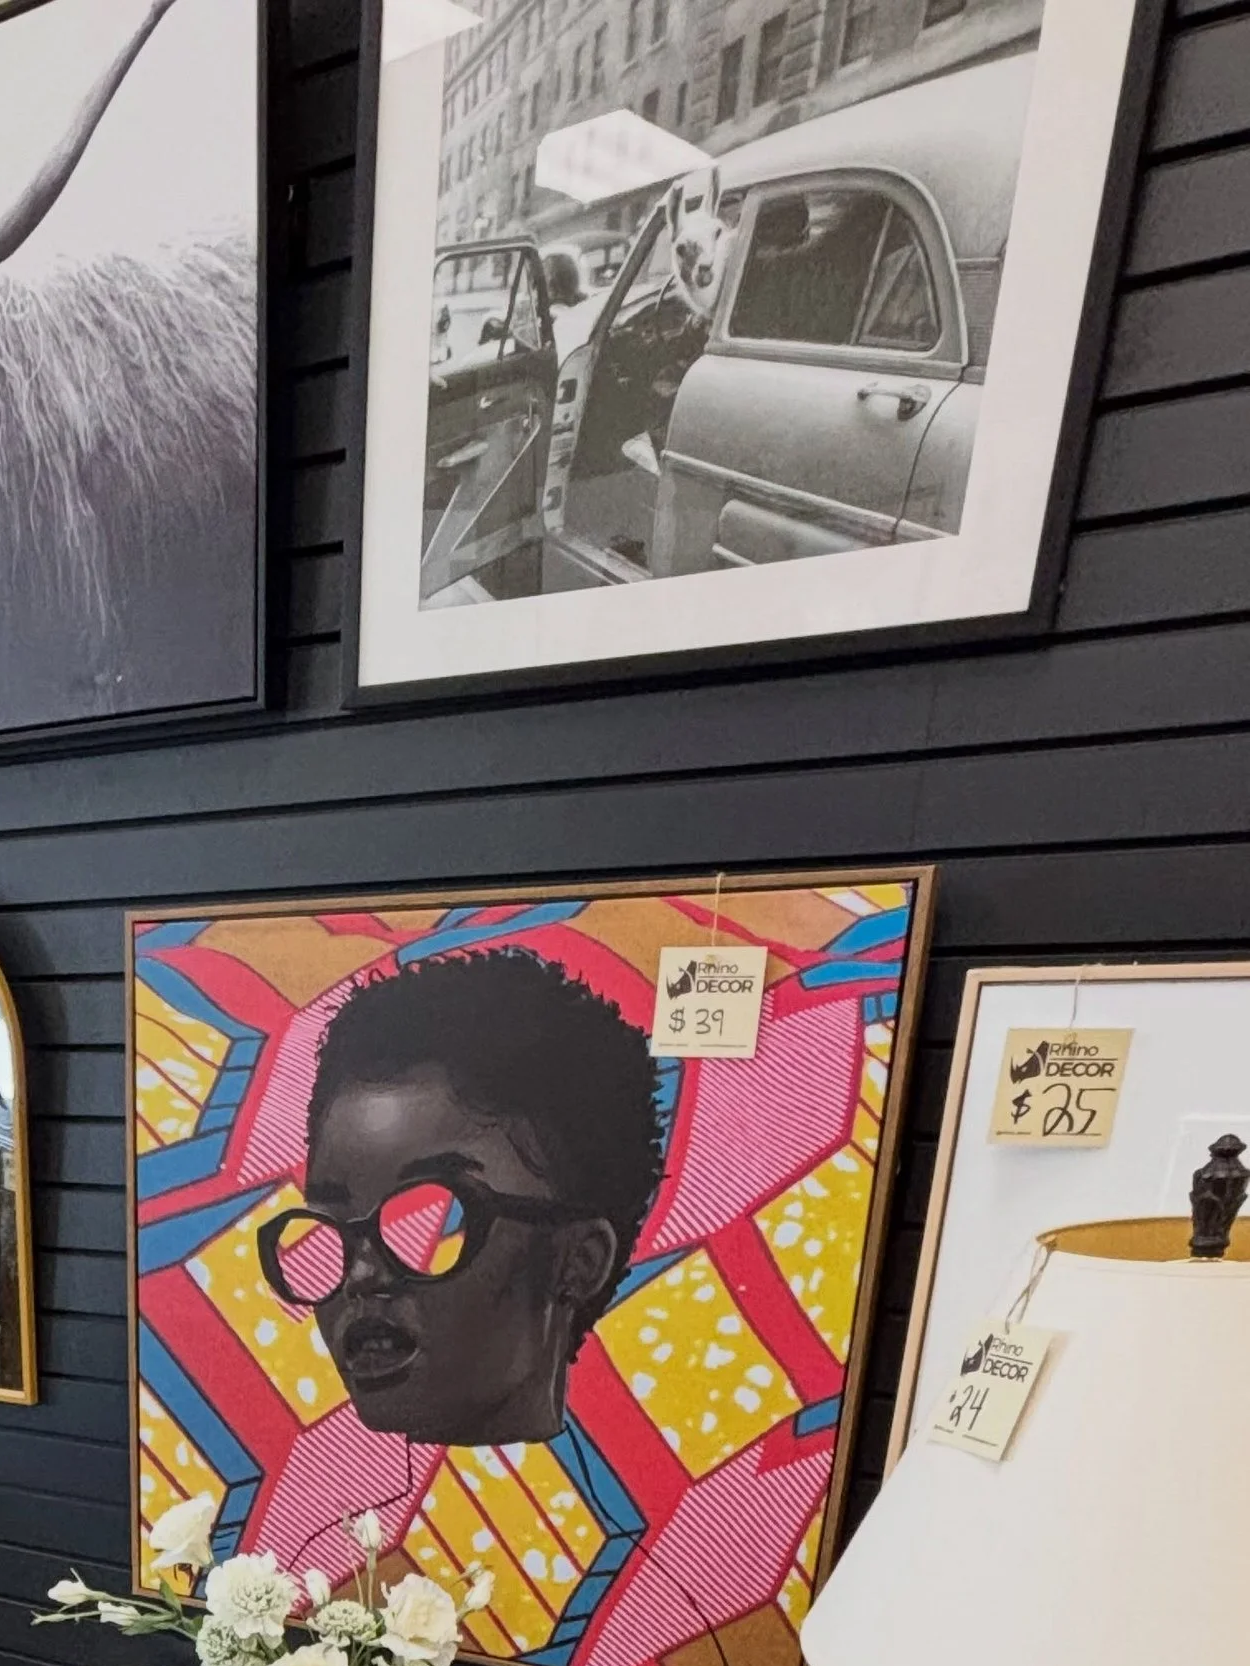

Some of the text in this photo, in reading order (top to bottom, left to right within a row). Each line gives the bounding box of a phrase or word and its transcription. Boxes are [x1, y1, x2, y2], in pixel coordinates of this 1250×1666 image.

[698, 963, 739, 974] Rhino
[696, 980, 754, 994] DECOR
[695, 1009, 724, 1037] 39
[1049, 1042, 1099, 1057] Rhino
[1045, 1062, 1116, 1078] DECOR
[1042, 1083, 1117, 1137] 25
[991, 1337, 1025, 1358] Rhino
[982, 1358, 1029, 1382] DECOR
